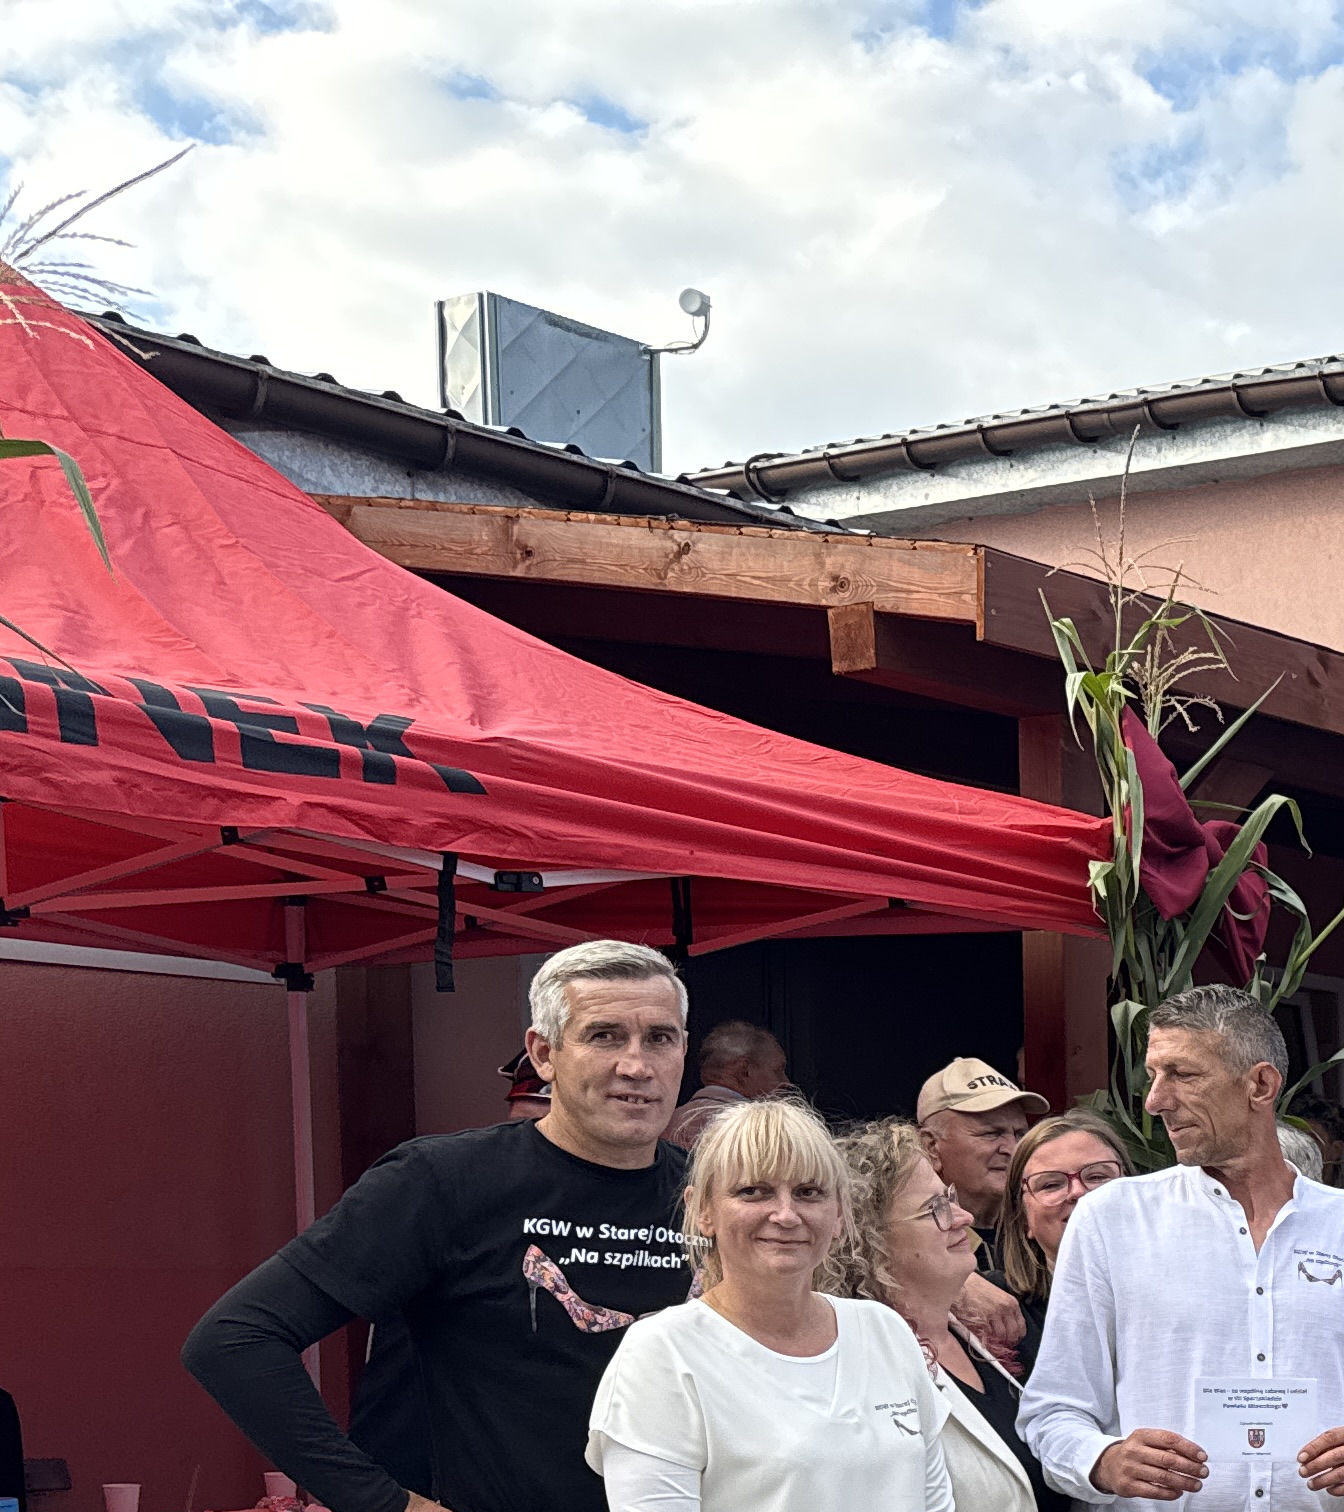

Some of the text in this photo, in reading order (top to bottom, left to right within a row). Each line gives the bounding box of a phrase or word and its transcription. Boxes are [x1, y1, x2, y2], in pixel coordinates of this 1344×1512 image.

[523, 1218, 571, 1237] KGW
[576, 1225, 594, 1238] w
[598, 1223, 654, 1244] Starej
[558, 1248, 599, 1265] „Na
